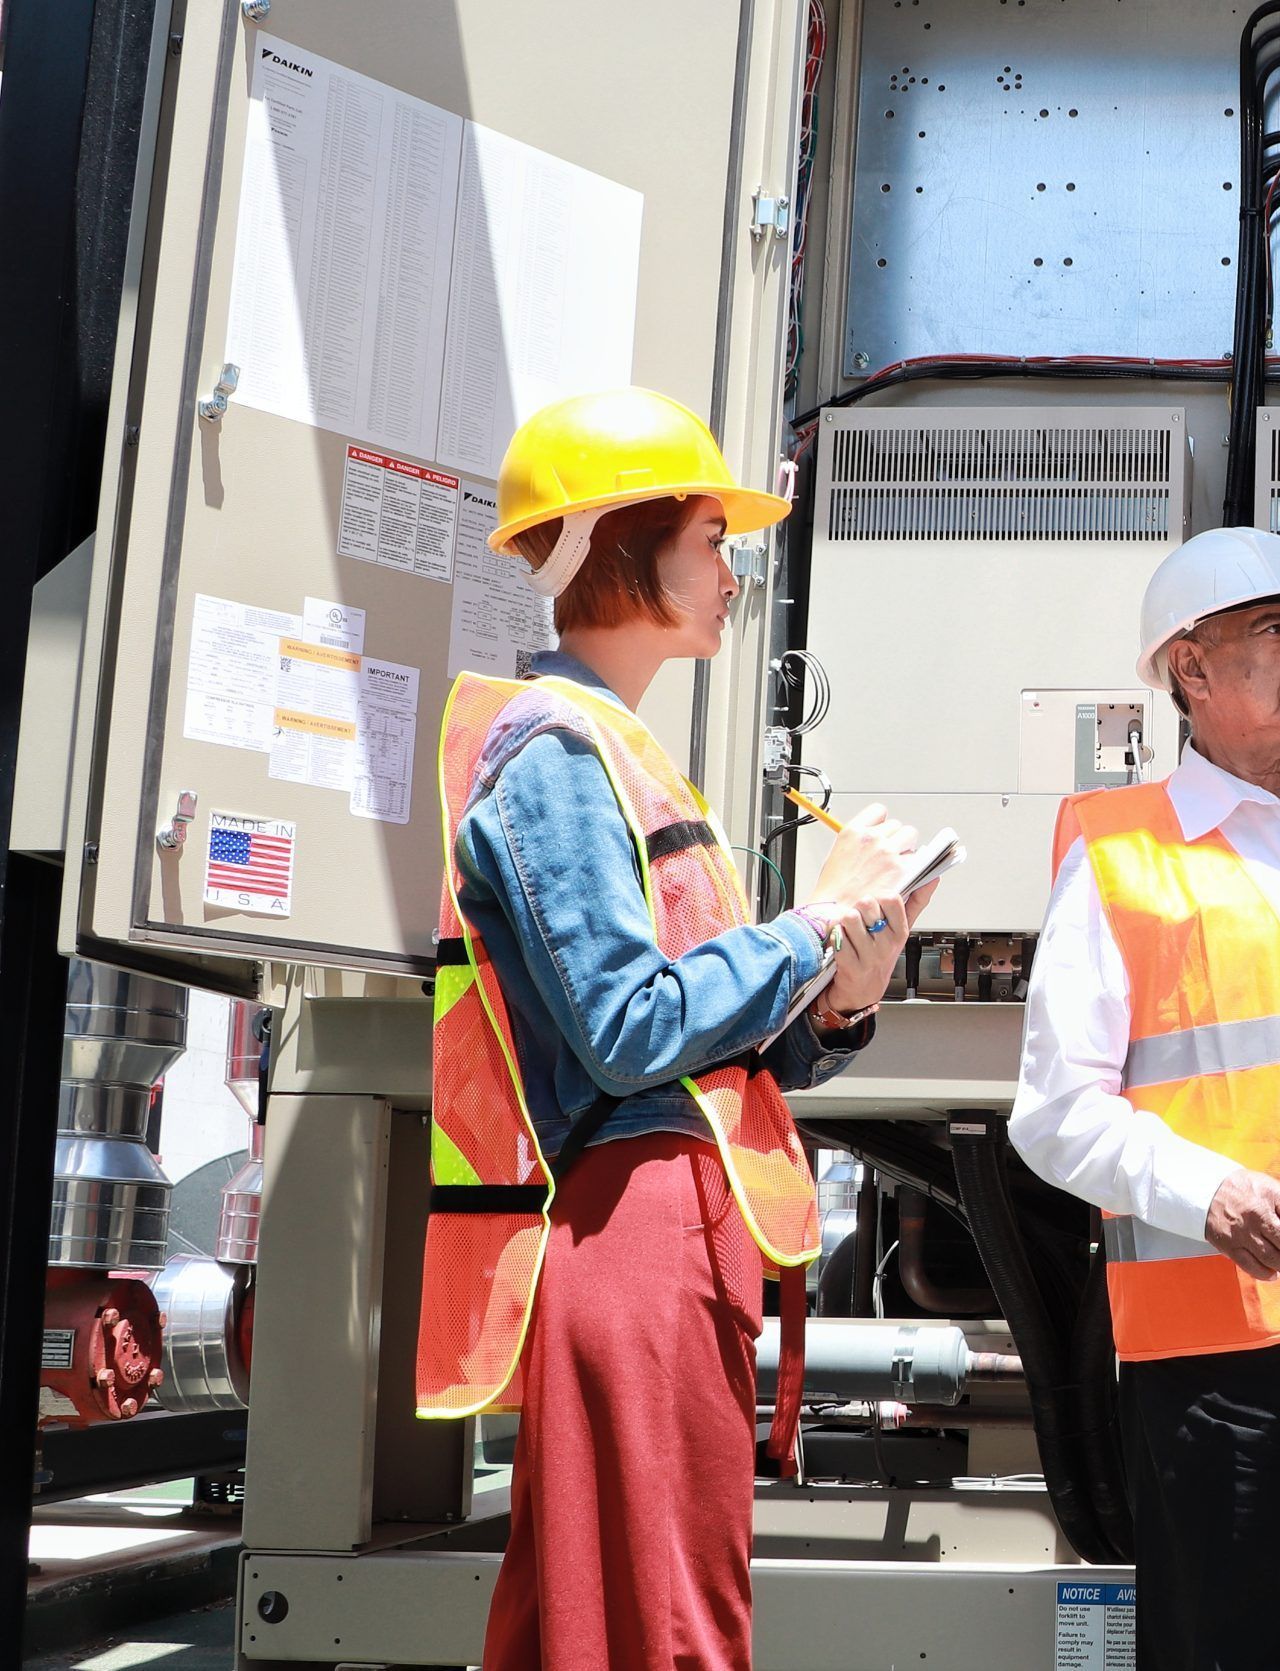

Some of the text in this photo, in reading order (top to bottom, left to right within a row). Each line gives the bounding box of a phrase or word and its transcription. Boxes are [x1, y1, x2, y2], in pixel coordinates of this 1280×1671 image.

[272, 55, 313, 77] DAIKIN
[359, 451, 383, 464] DANGER
[396, 463, 420, 475] DANGER
[432, 474, 457, 486] PELIGRO
[471, 496, 497, 509] DAIKI
[286, 644, 312, 655] WARNING
[367, 666, 410, 683] IMPORTANT
[281, 715, 306, 725] WARNING
[211, 814, 293, 838] MADE IN
[1062, 1588, 1101, 1600] NOTICE
